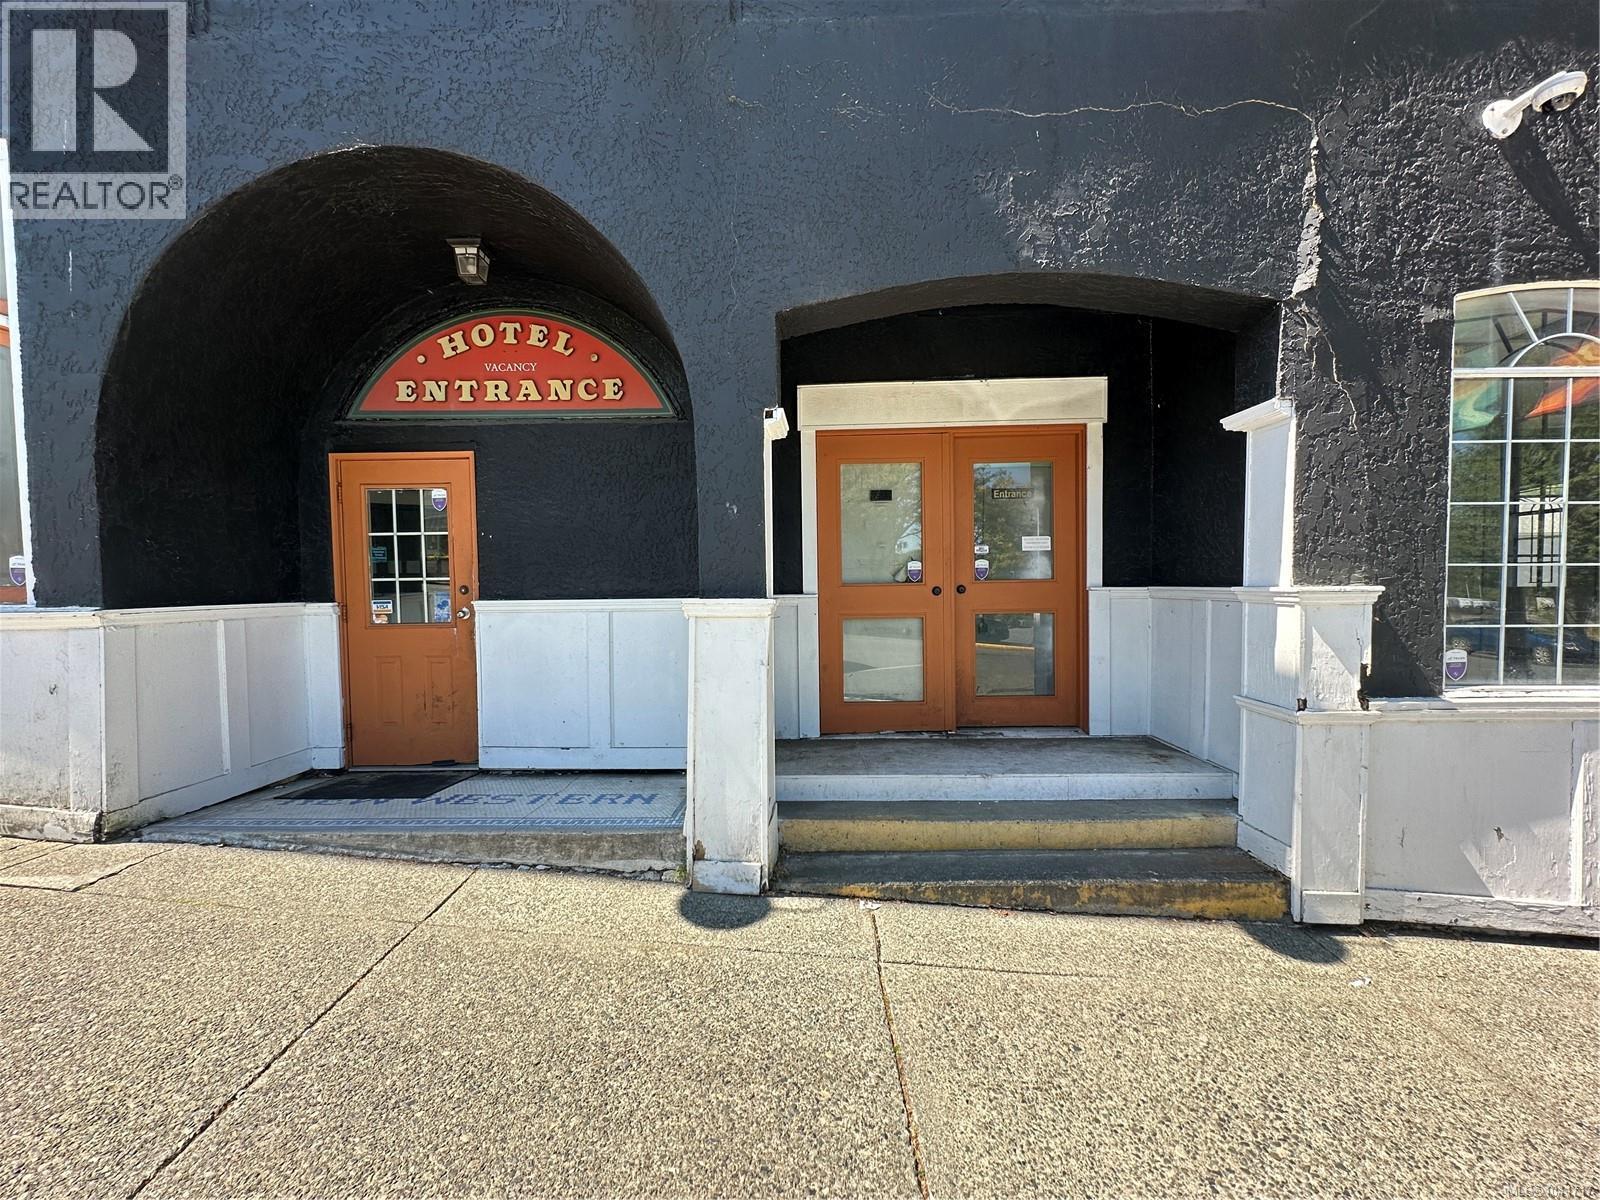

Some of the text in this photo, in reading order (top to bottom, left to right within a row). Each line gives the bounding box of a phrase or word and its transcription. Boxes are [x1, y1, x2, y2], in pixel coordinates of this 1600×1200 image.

[437, 322, 575, 359] HOTEL
[484, 362, 538, 373] VACANCY
[395, 378, 625, 403] ENTRANCE
